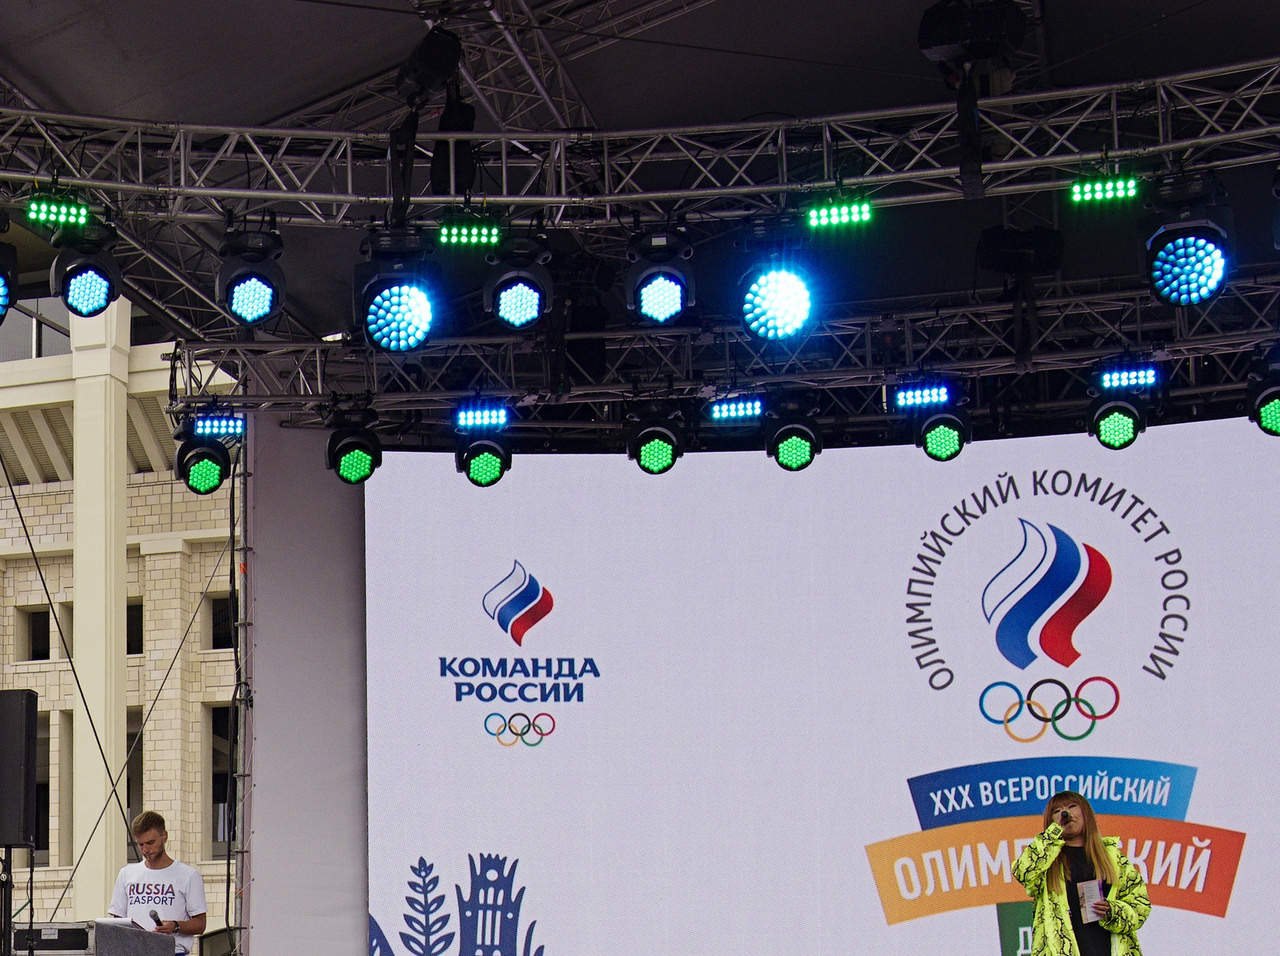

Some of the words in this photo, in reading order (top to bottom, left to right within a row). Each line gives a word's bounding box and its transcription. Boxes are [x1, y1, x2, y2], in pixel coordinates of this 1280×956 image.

[906, 472, 1020, 691] ОЛИМПИЙСКИЙ
[1032, 469, 1170, 543] КОМИТЕТ
[1142, 548, 1191, 681] РОССИИ
[438, 656, 601, 680] КОМАНДА
[454, 681, 584, 703] РОССИИ
[129, 883, 176, 896] RUSSIA
[129, 896, 175, 906] ZASPORT
